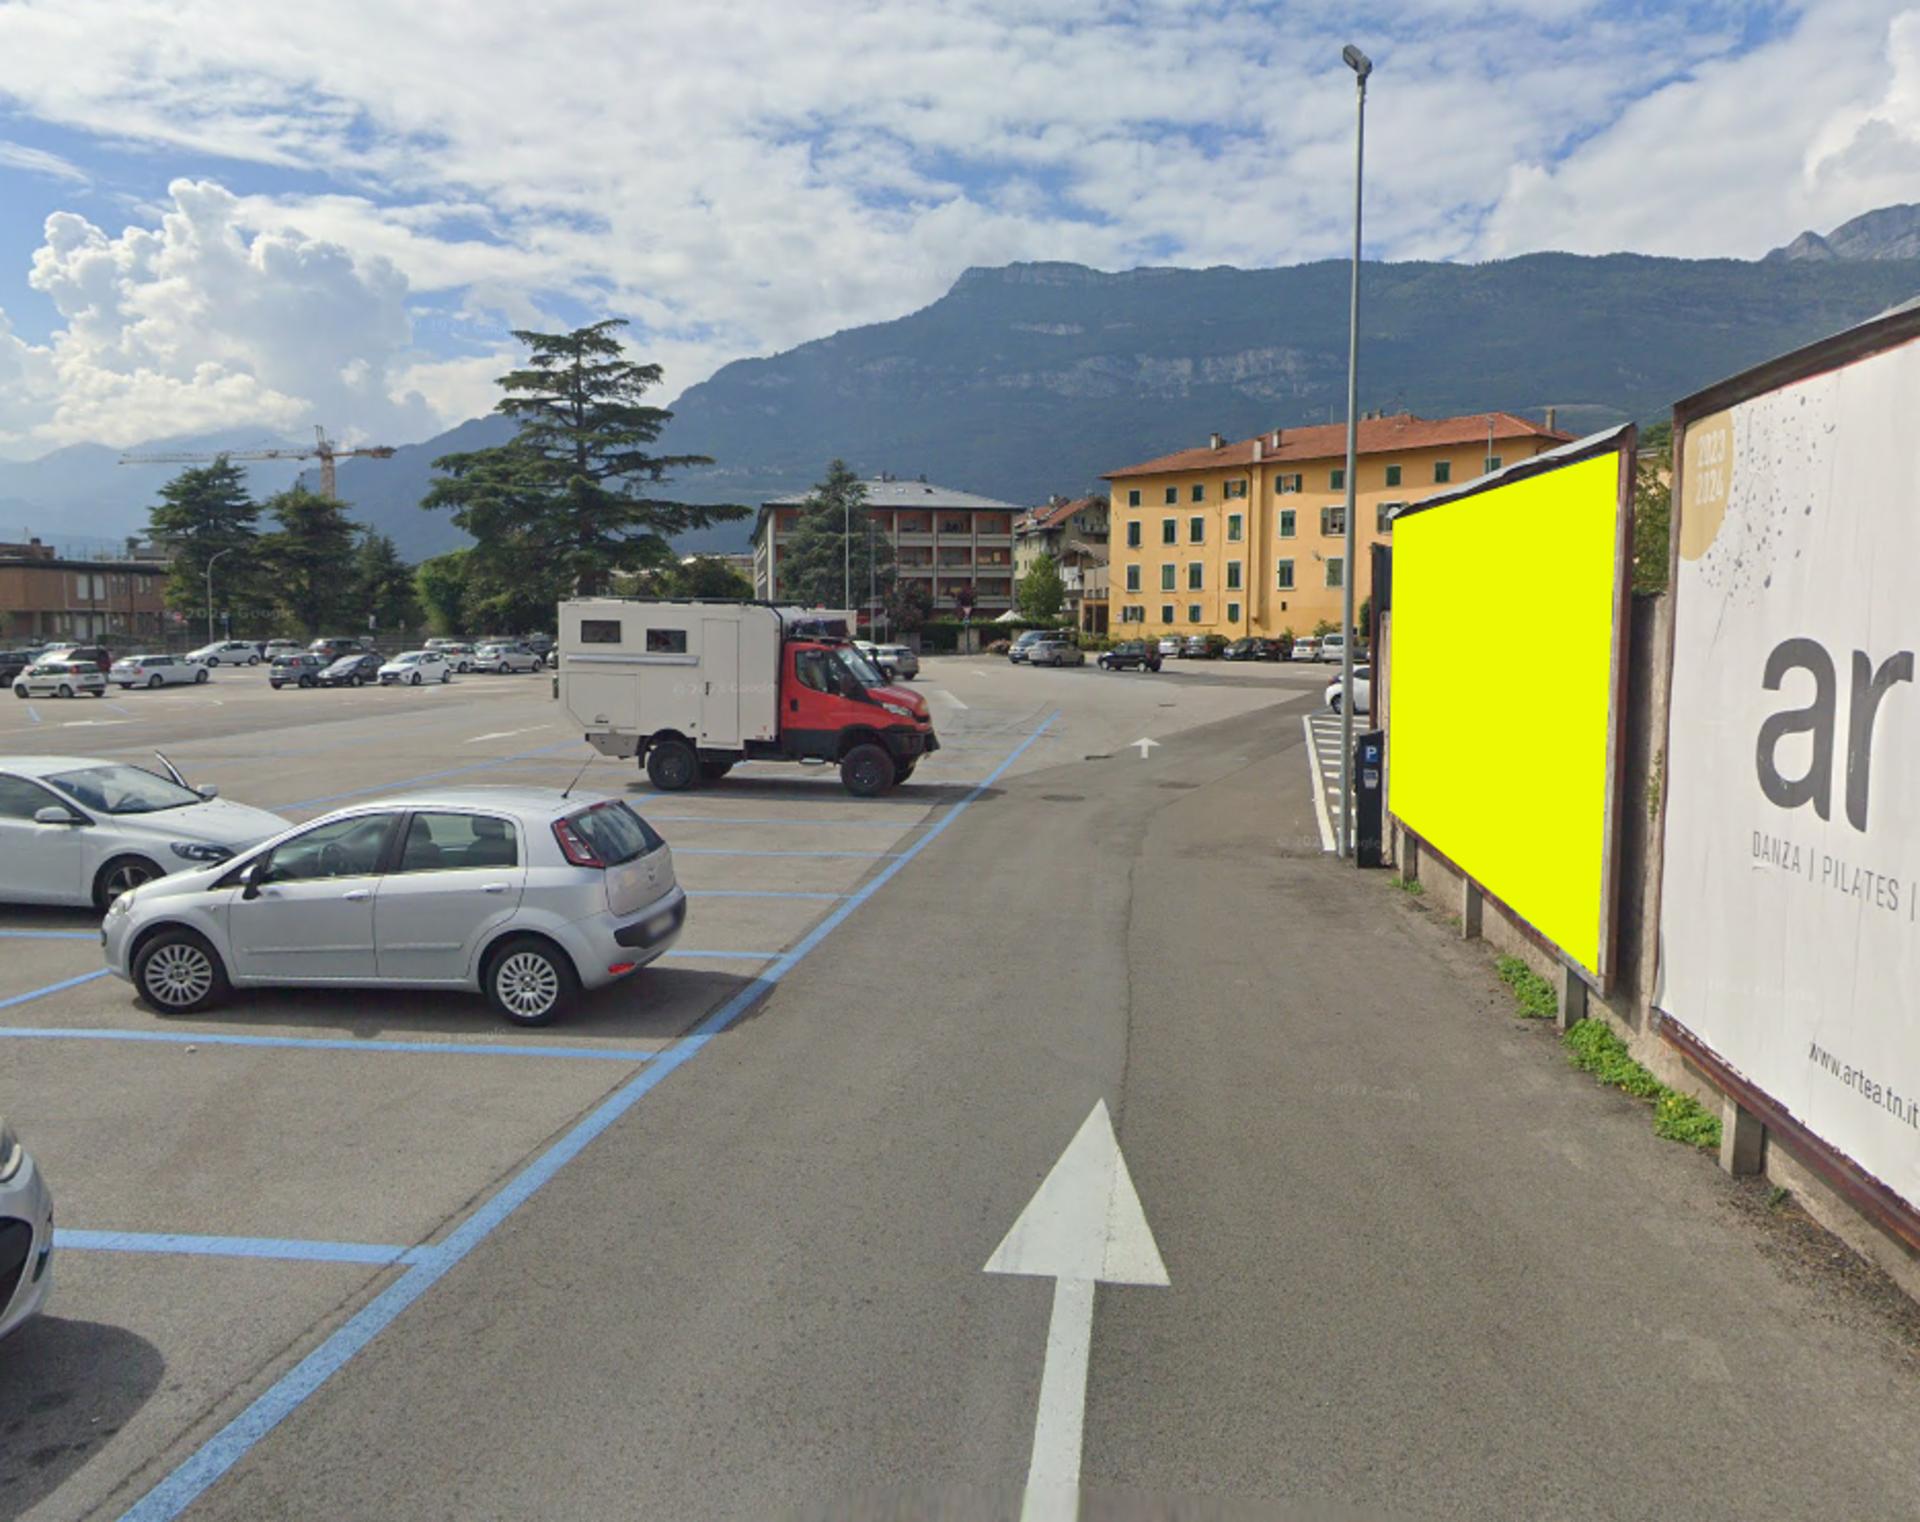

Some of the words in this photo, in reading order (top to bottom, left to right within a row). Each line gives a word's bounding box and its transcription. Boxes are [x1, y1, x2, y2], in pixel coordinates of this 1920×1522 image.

[1697, 429, 1726, 466] 2023
[1696, 468, 1724, 505] 2024
[1366, 746, 1377, 759] P
[1756, 637, 1915, 832] ar
[1753, 831, 1801, 873] DANZA
[1823, 856, 1900, 911] PILATES
[1809, 1043, 1919, 1128] www.artea.tn.it
